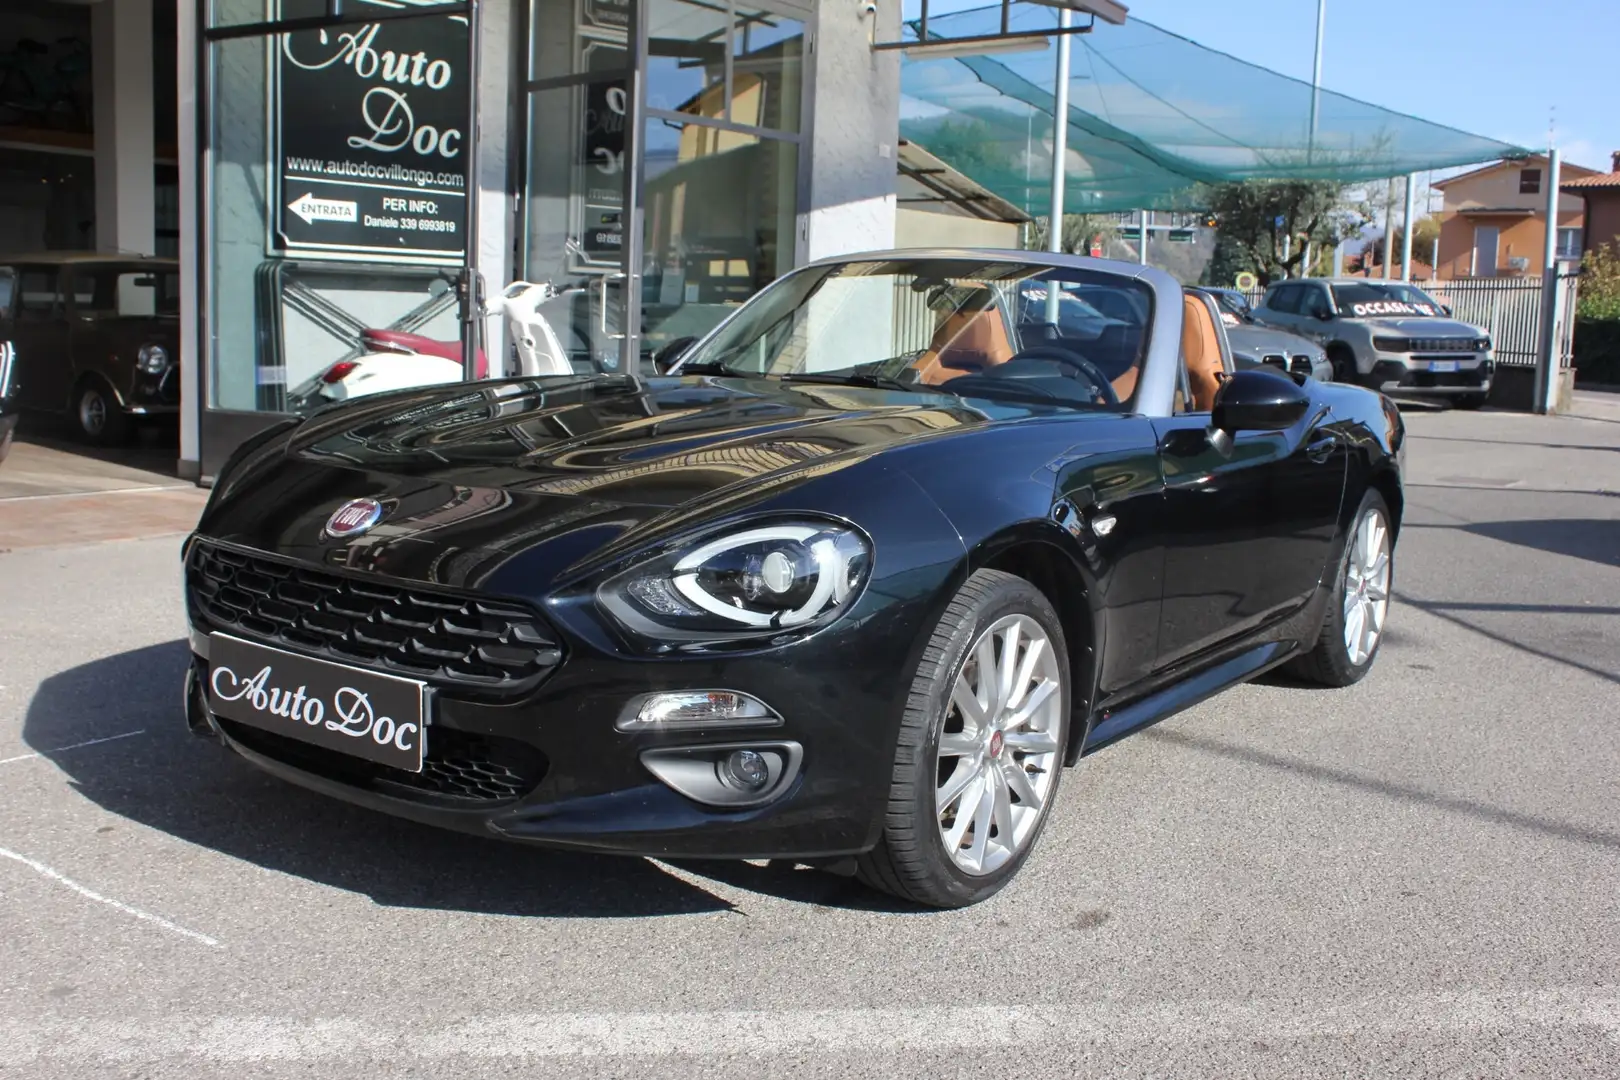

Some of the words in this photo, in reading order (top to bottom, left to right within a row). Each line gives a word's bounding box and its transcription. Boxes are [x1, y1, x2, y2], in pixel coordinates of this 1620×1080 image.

[283, 23, 451, 90] Auto
[347, 86, 461, 158] Doc
[286, 156, 464, 187] www.autodocvillongo.com
[301, 203, 352, 217] ENTRATA
[383, 197, 407, 212] PER
[409, 200, 439, 214] INFO:
[364, 215, 399, 229] Daniele
[400, 218, 417, 230] 339
[212, 666, 325, 725] Auto
[325, 686, 417, 751] Doc
